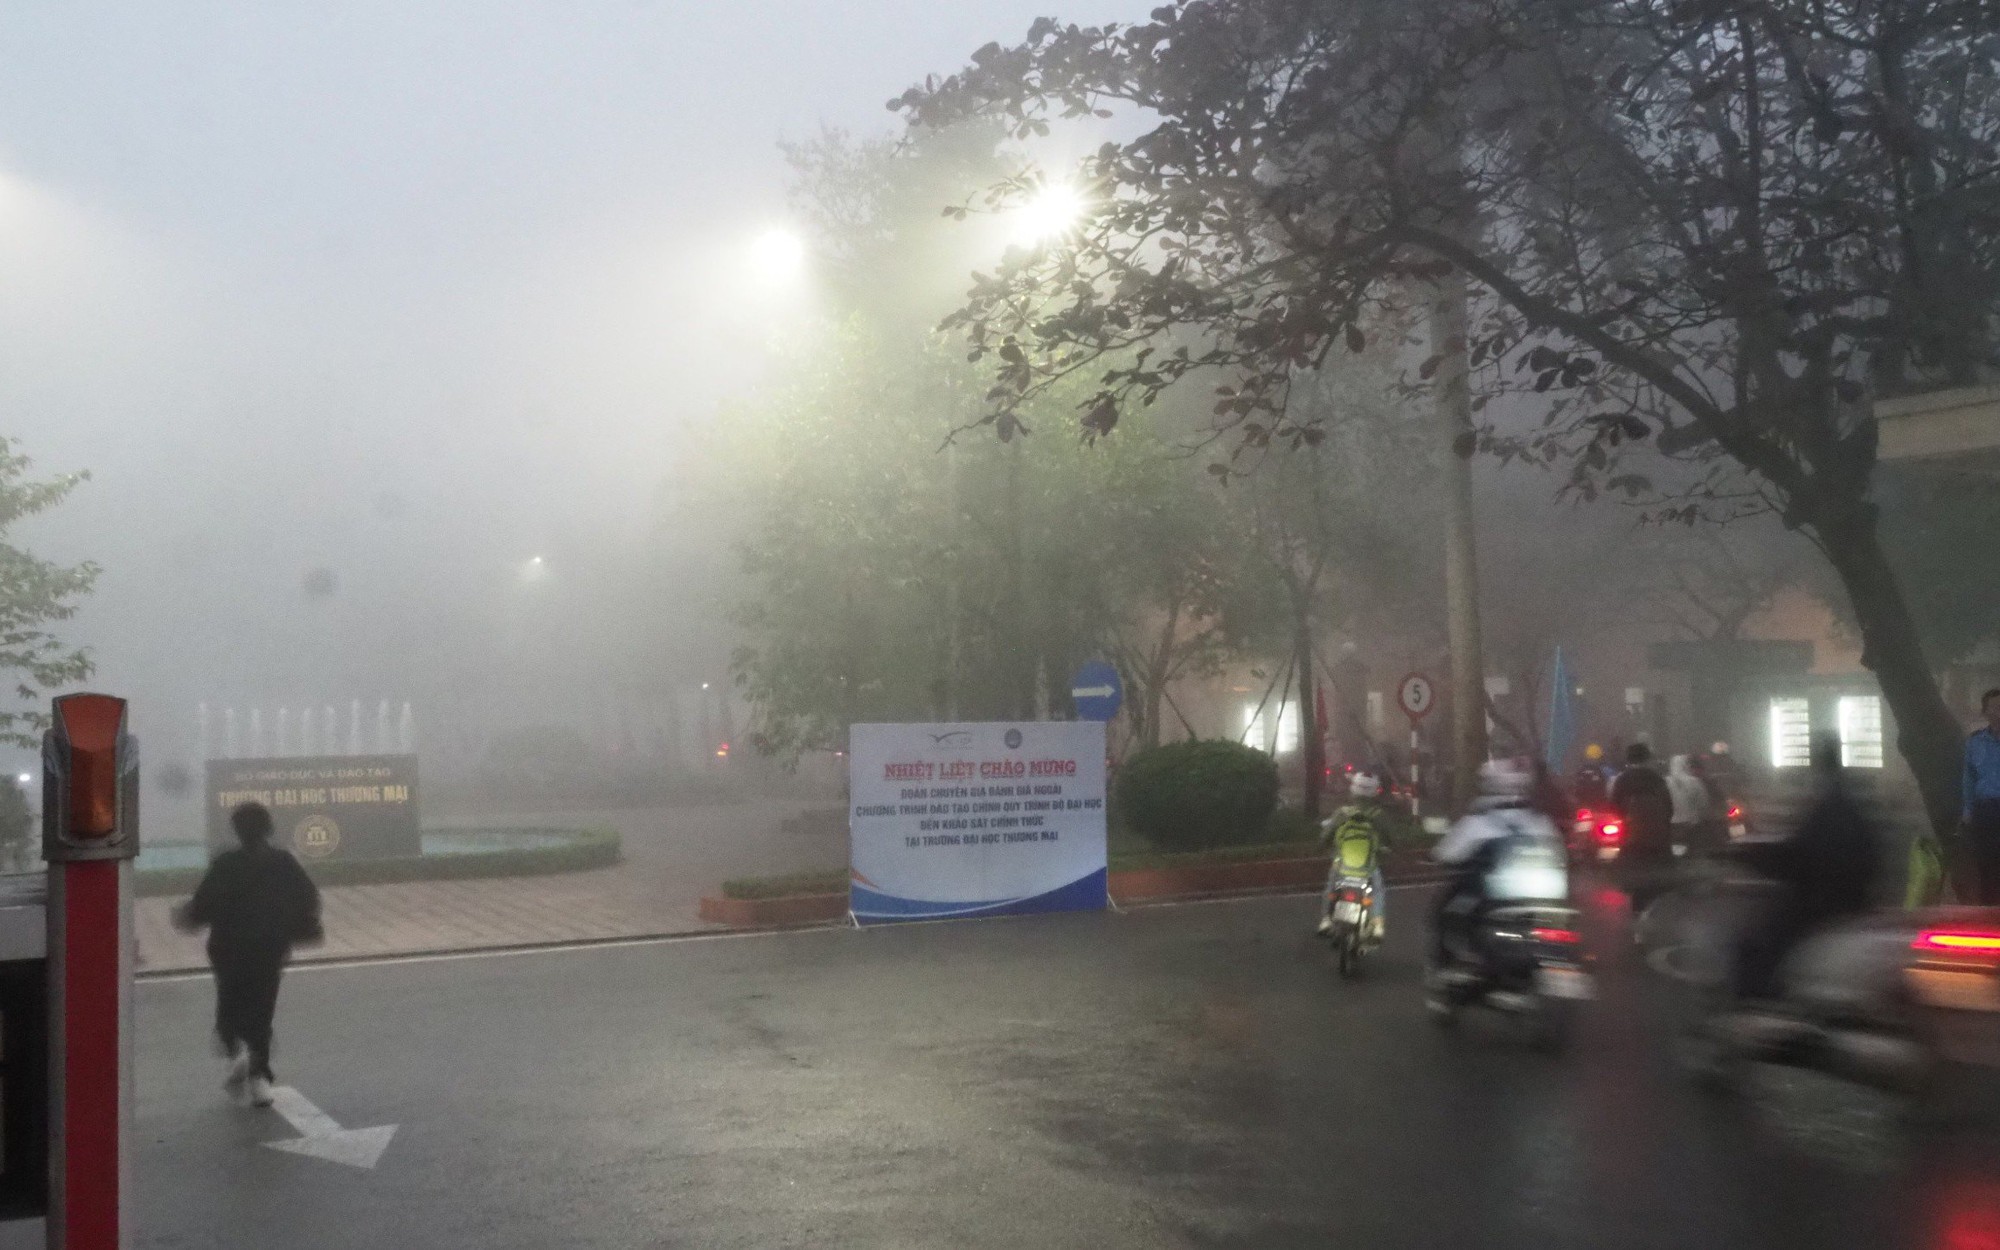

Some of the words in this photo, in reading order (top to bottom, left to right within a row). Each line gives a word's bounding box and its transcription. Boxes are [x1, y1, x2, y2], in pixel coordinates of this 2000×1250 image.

[1413, 684, 1421, 704] 5
[884, 760, 934, 781] NHIỆT
[939, 760, 976, 781] LIỆT
[980, 759, 1026, 779] CHÀO
[1029, 758, 1076, 778] MỪNG
[930, 785, 968, 799] CHUYÊN
[1040, 830, 1058, 844] MẠI
